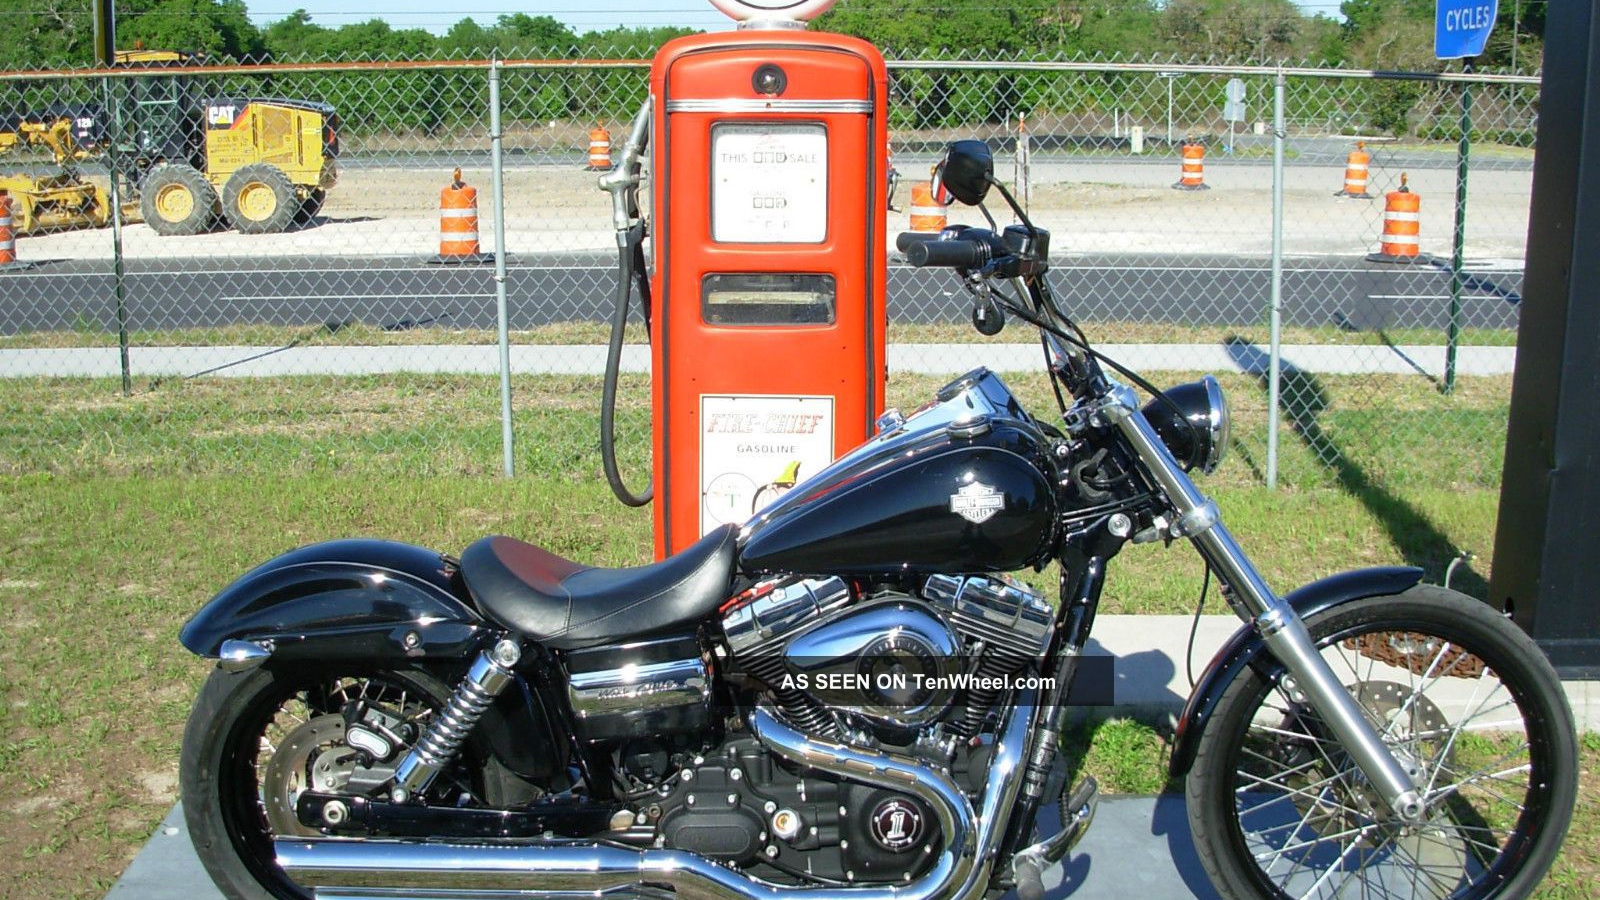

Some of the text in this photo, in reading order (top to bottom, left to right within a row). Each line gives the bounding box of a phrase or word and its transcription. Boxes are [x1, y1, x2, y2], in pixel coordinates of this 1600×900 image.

[1446, 6, 1490, 31] CYCLES
[208, 106, 236, 125] CAT
[721, 153, 818, 163] THIS SALE
[737, 445, 797, 453] GASOLINE
